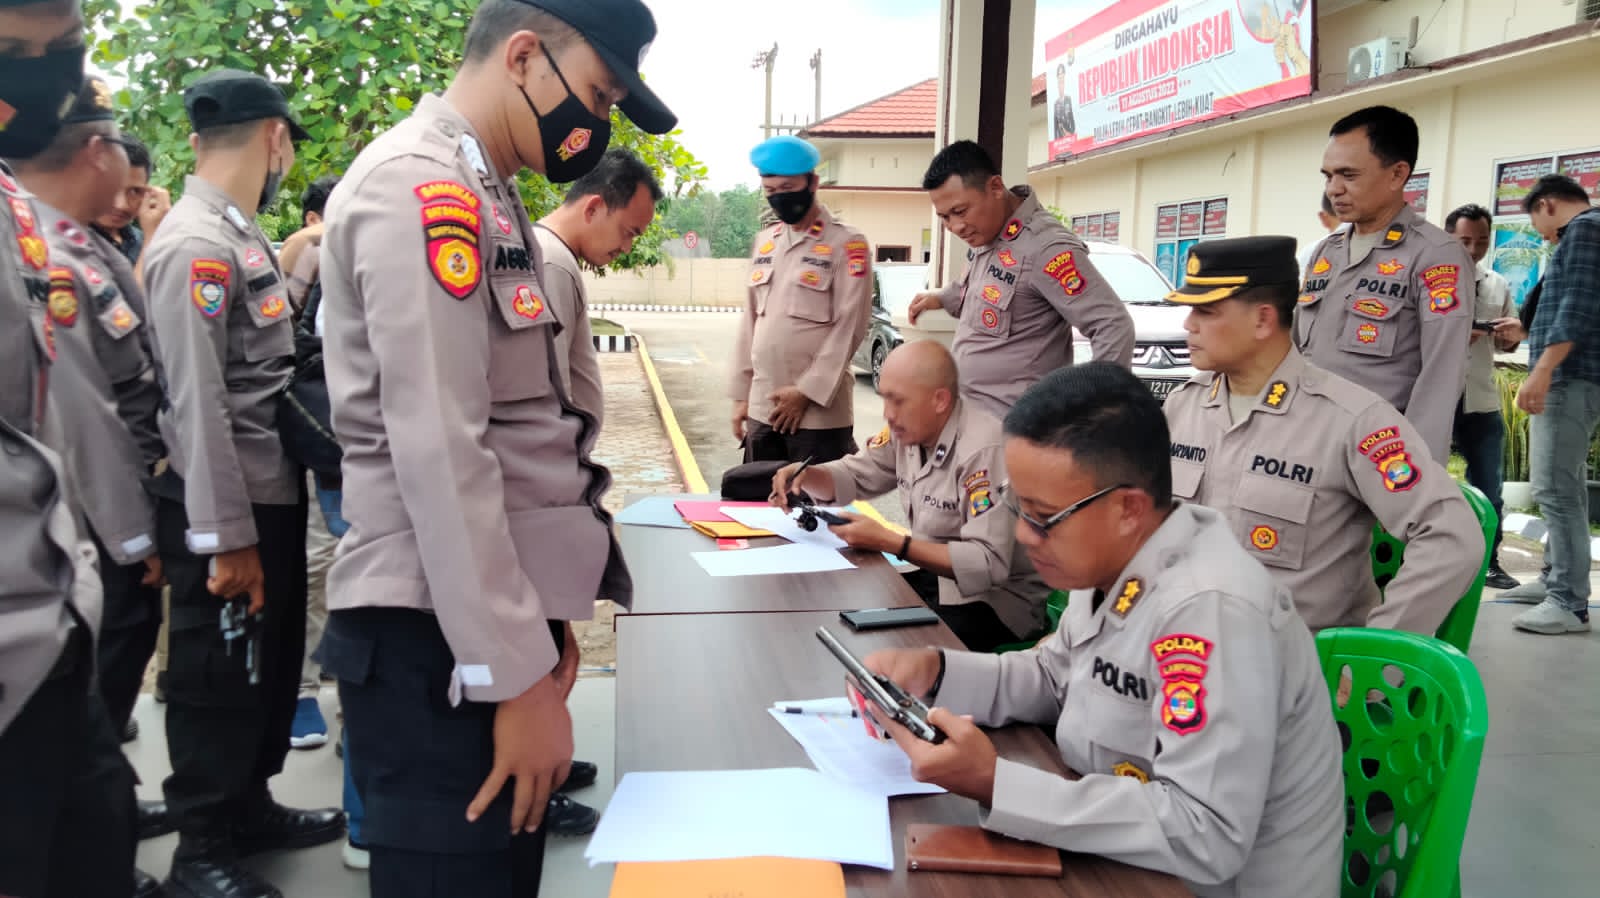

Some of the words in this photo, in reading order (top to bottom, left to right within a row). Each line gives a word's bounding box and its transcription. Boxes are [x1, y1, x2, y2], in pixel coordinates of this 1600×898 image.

[1115, 6, 1178, 49] DIRGAHAYU
[1078, 47, 1140, 104] REPUBLIK
[1142, 9, 1233, 78] INDONESIA
[1174, 98, 1193, 121] LEBIH
[1195, 92, 1214, 114] KUAT
[1501, 162, 1552, 181] PRESIS
[987, 264, 1016, 286] POLRI
[1356, 278, 1407, 298] POLRI
[1361, 430, 1395, 450] POLDA
[1251, 455, 1313, 484] POLRI
[923, 495, 960, 511] POLRI
[1154, 638, 1205, 657] POLDA
[1091, 656, 1148, 700] POLRI
